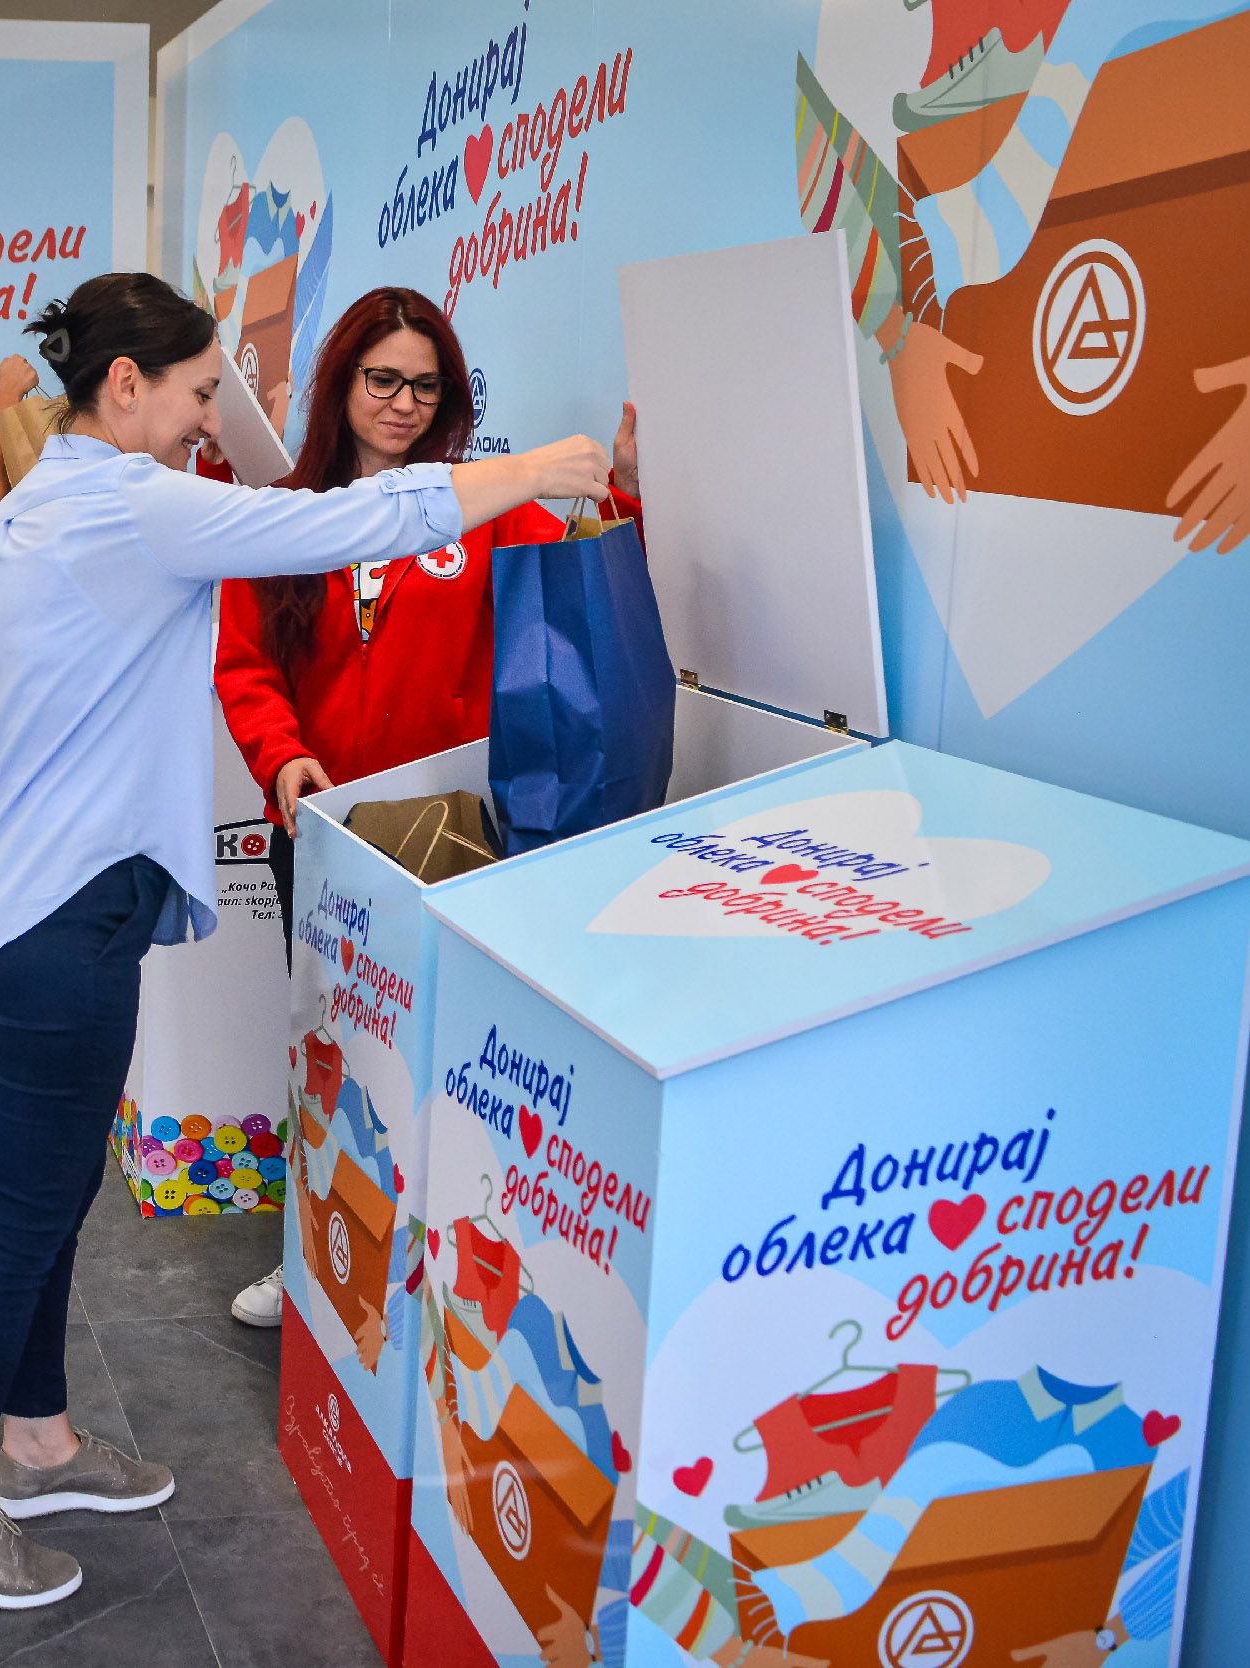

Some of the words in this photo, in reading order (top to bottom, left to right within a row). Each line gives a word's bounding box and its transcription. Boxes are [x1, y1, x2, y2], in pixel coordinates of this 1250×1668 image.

[418, 0, 529, 158] Донирај
[378, 154, 458, 248] облека
[498, 47, 632, 193] сподели
[444, 151, 588, 321] добрина!
[650, 832, 774, 873] облека
[796, 880, 972, 940] сподели
[740, 829, 930, 881] Донирај
[299, 912, 338, 964] облека
[356, 953, 414, 1013] сподели
[318, 878, 372, 946] Донирај
[658, 881, 882, 946] добрина!
[330, 982, 397, 1049] добрина!
[479, 1024, 575, 1126] Донирај
[445, 1062, 515, 1139] облека
[546, 1134, 651, 1233] сподели
[821, 1108, 1055, 1209] Донирај
[501, 1164, 619, 1275] добрина!
[722, 1214, 915, 1283] облека
[997, 1164, 1211, 1246] сподели
[885, 1223, 1149, 1341] добрина!
